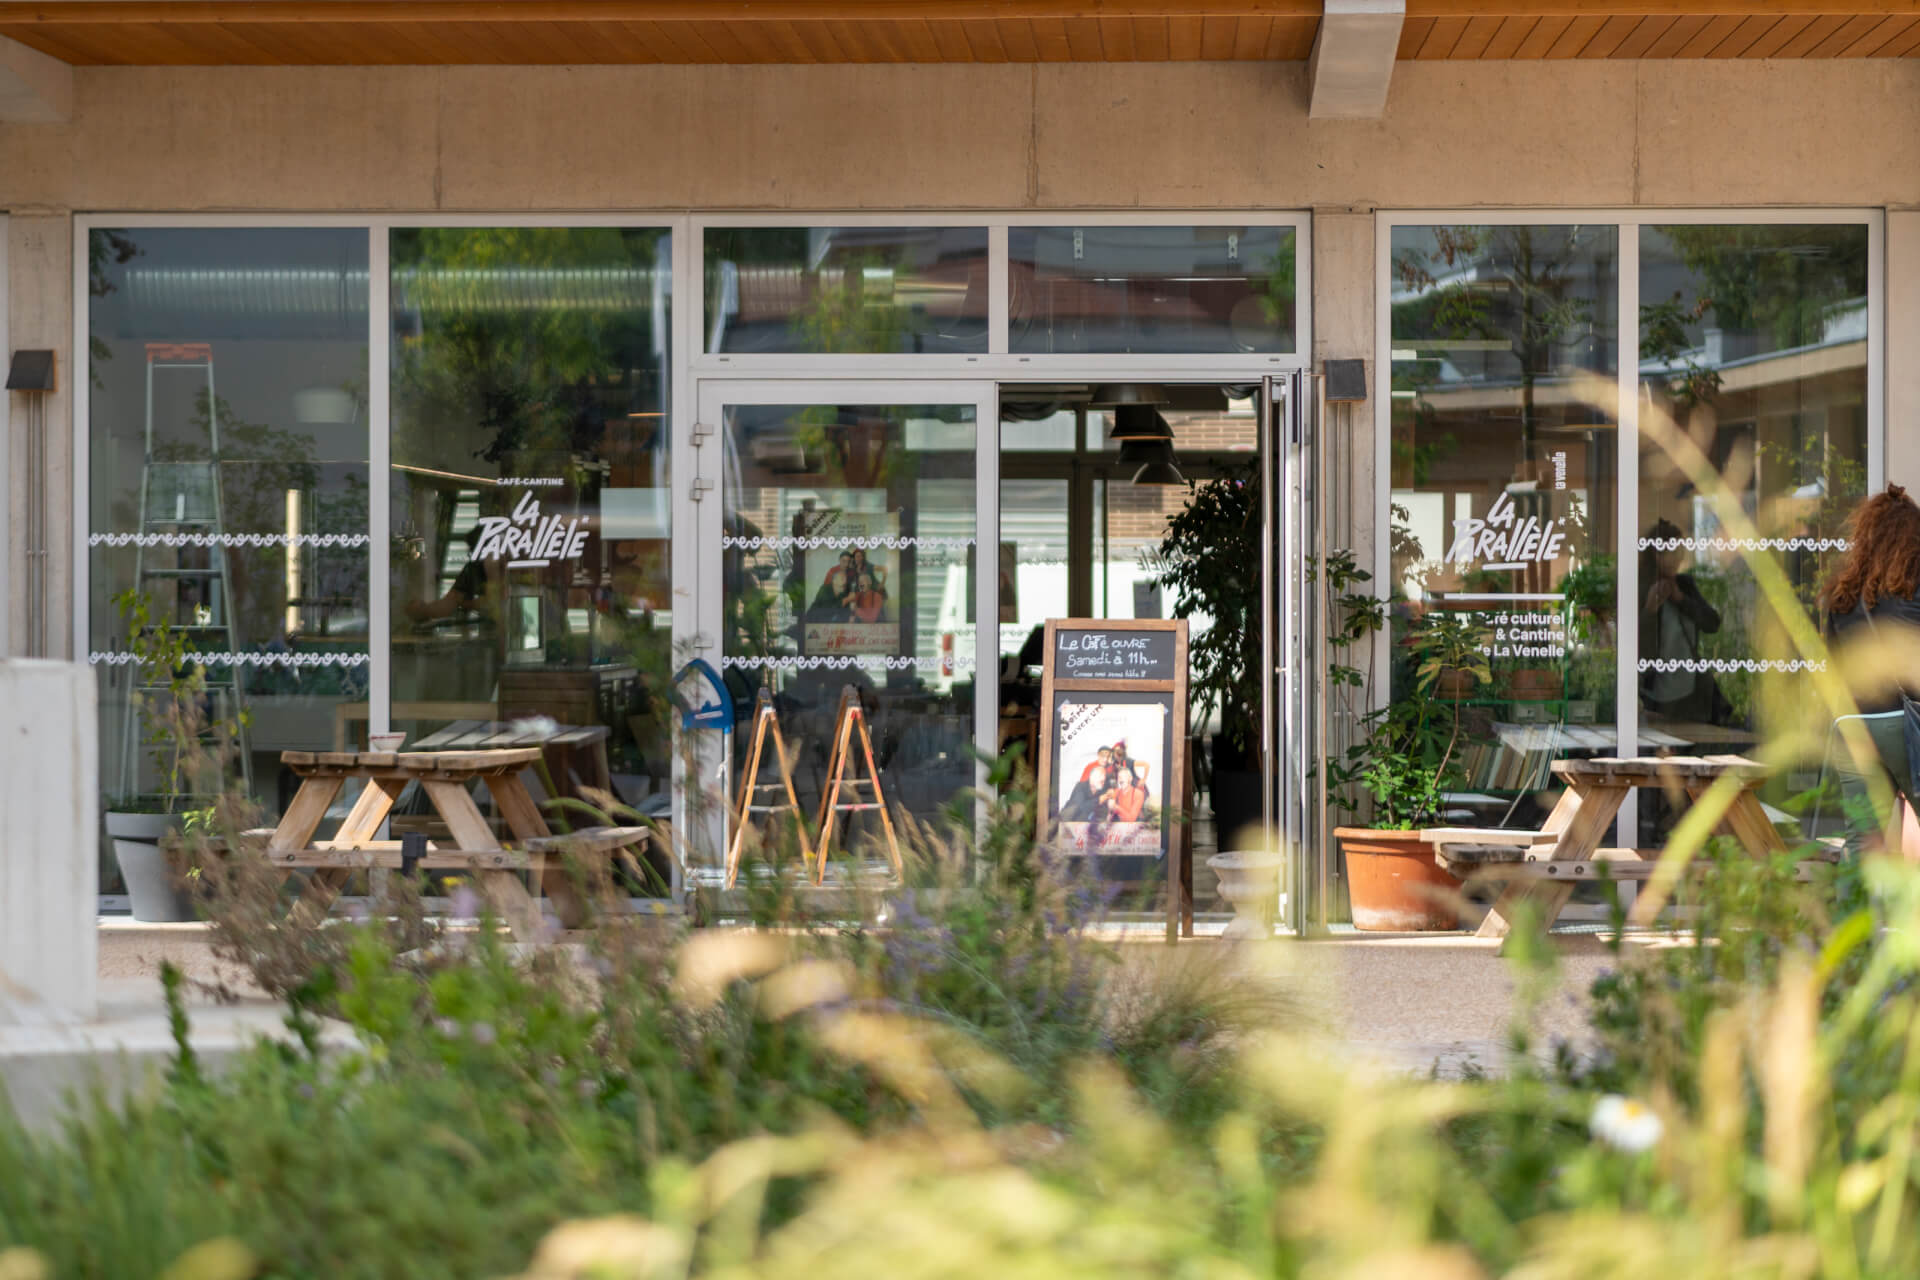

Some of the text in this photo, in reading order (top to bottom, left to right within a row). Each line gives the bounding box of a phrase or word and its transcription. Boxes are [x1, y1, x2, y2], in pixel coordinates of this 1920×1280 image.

[512, 489, 540, 527] LA
[1486, 491, 1515, 529] LA
[1510, 611, 1565, 625] culturel
[1059, 633, 1079, 650] Le
[1495, 627, 1565, 641] & Cantine
[1493, 644, 1510, 657] La
[1512, 644, 1565, 657] Venelle
[1066, 651, 1112, 668] Samedi
